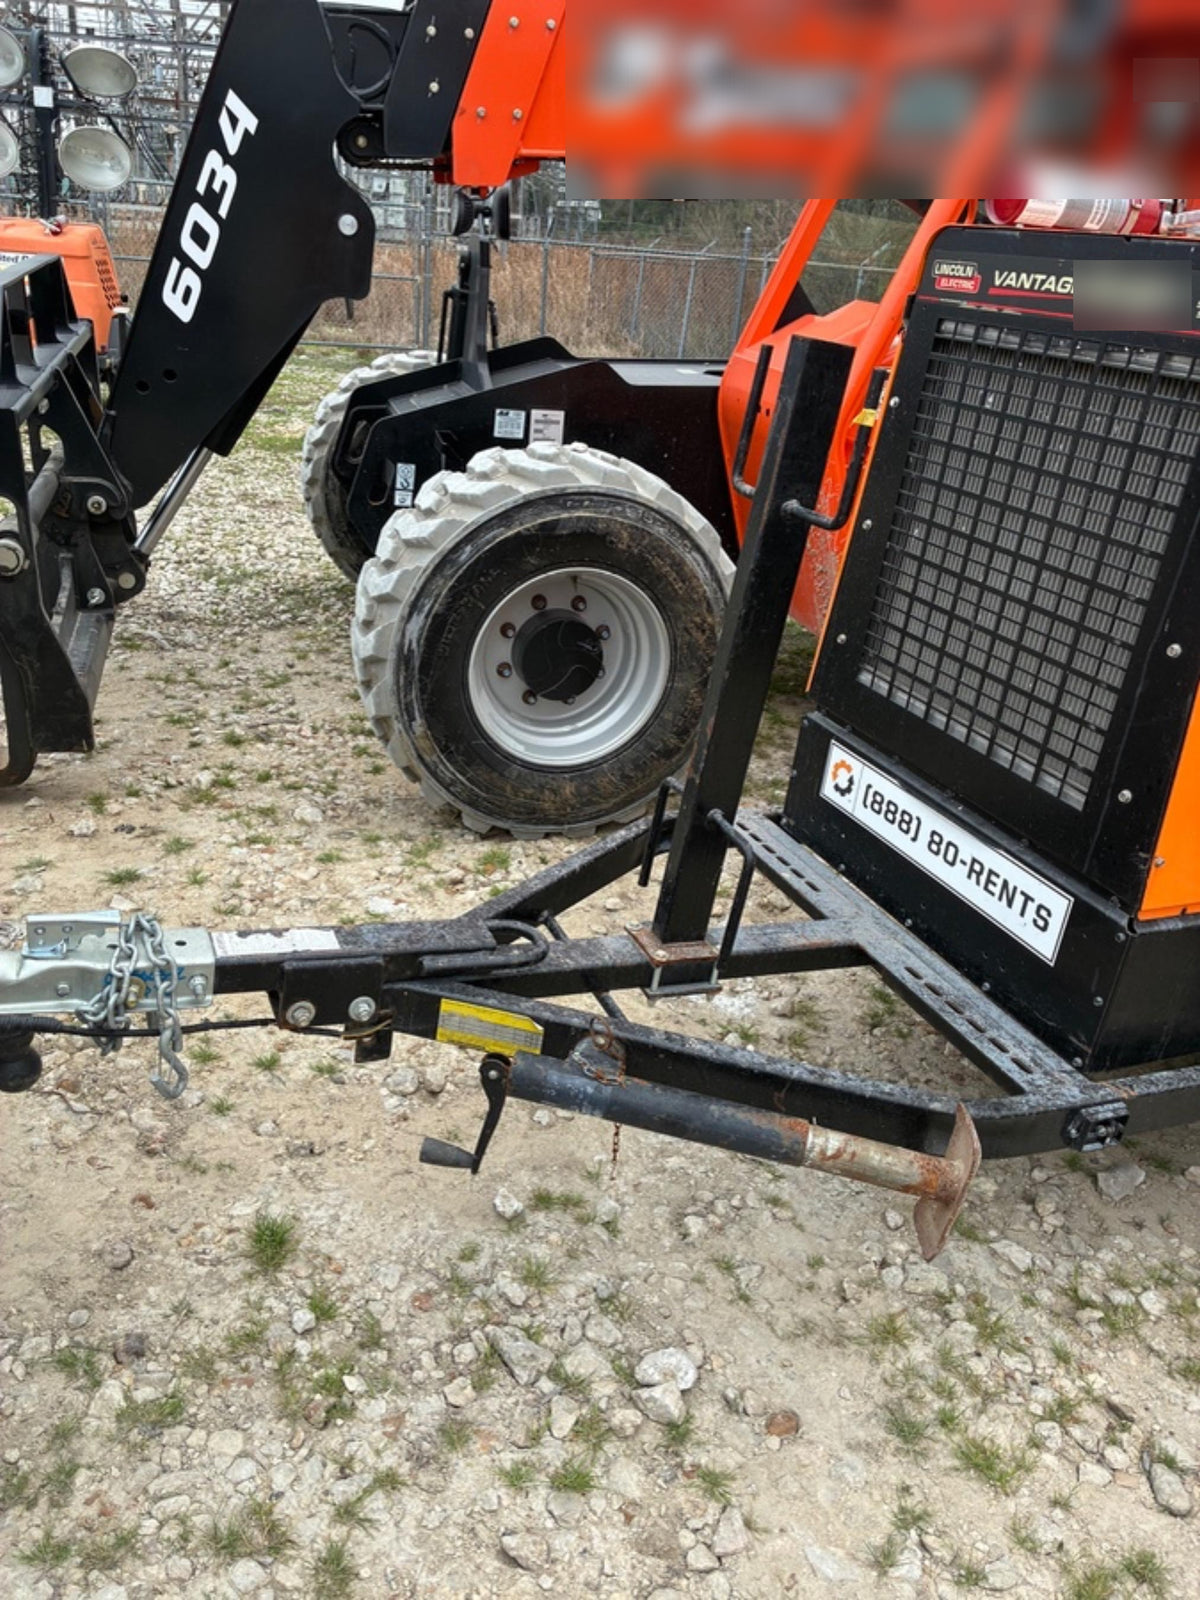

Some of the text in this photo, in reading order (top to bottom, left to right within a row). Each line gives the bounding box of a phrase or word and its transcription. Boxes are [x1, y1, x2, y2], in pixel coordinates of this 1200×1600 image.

[162, 88, 259, 323] 6034
[934, 263, 974, 277] LINCOLN
[993, 270, 1074, 294] VANTAG
[940, 278, 976, 289] ELECTRIC
[863, 784, 1052, 932] (888) 80-RENTS
